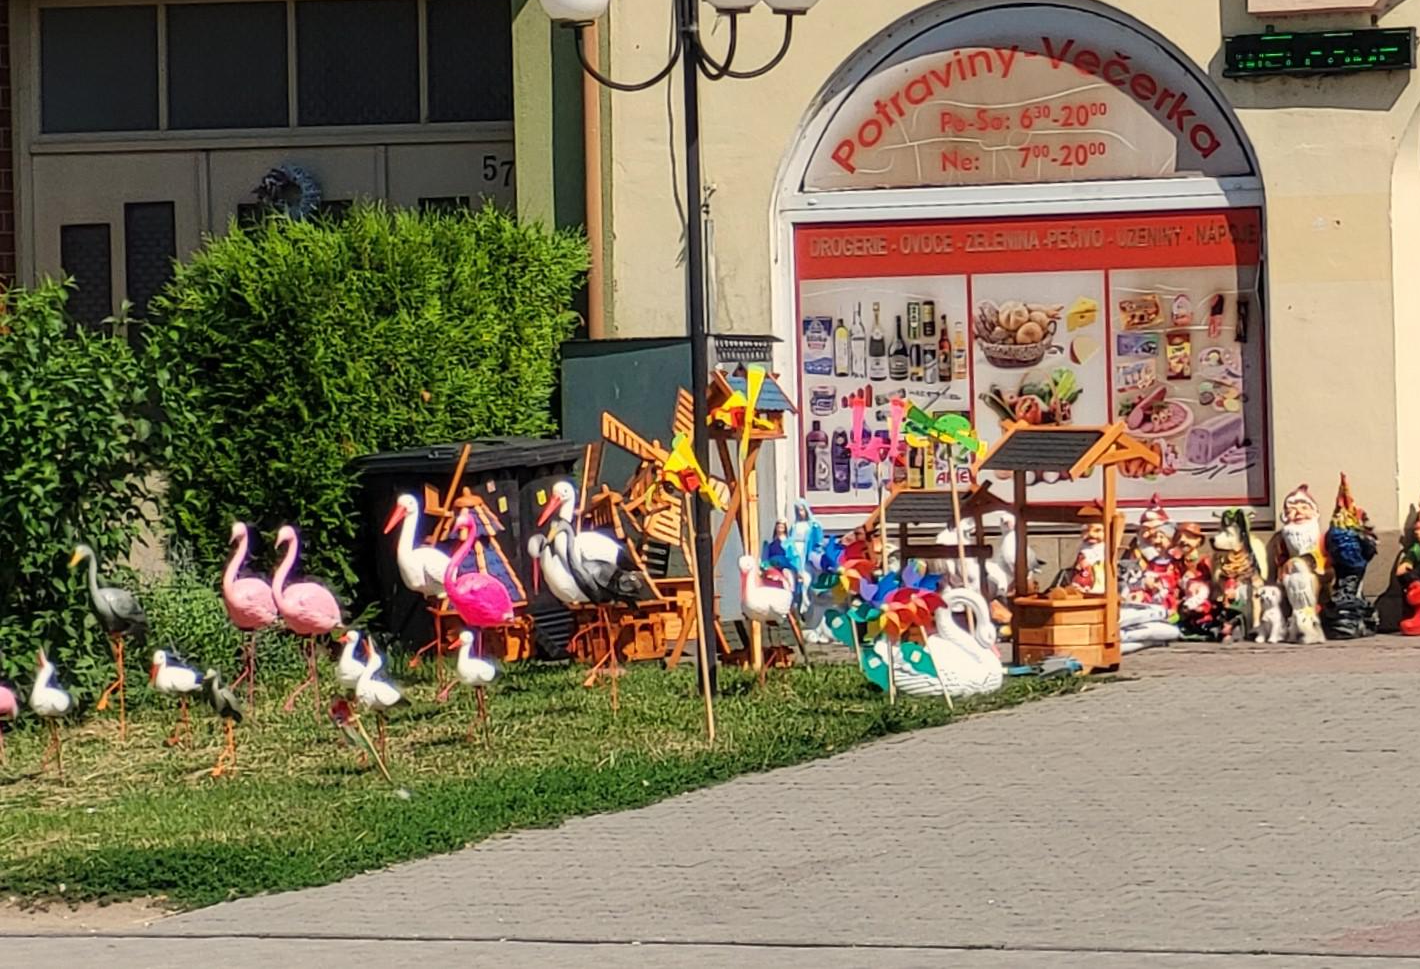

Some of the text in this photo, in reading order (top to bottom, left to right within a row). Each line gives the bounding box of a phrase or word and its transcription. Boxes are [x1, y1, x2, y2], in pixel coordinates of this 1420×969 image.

[831, 36, 1222, 174] Potraviny-Večerka
[483, 155, 514, 187] 57
[941, 151, 979, 172] Ne:
[810, 236, 889, 258] DROGERIE
[901, 233, 953, 255] OVOCE
[965, 229, 1040, 253] ZELENINA
[1117, 226, 1183, 248] UZENINY
